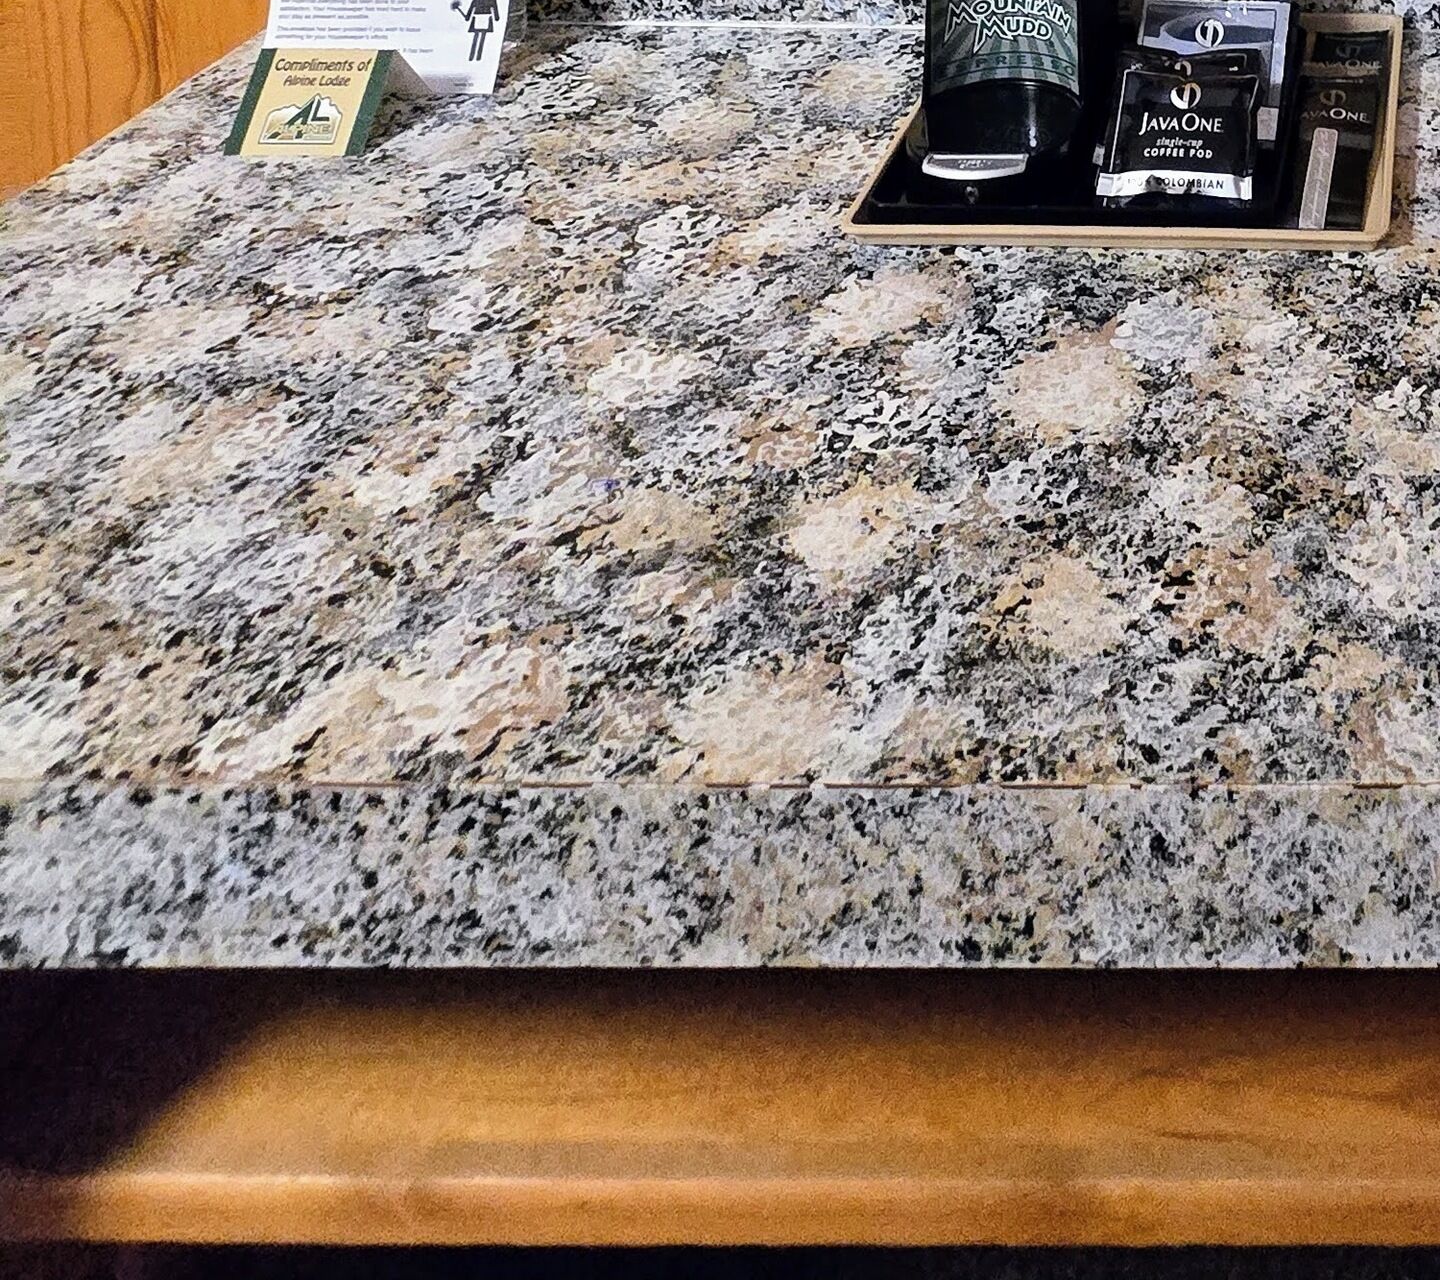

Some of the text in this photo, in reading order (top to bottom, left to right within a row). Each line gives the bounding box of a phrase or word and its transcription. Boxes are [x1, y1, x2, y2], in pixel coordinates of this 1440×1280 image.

[972, 15, 1052, 56] MUDD
[275, 58, 371, 72] Compliments of
[284, 74, 350, 87] Alpine Lodge
[1155, 137, 1203, 149] single-cup
[1143, 148, 1213, 159] COFFEE POD
